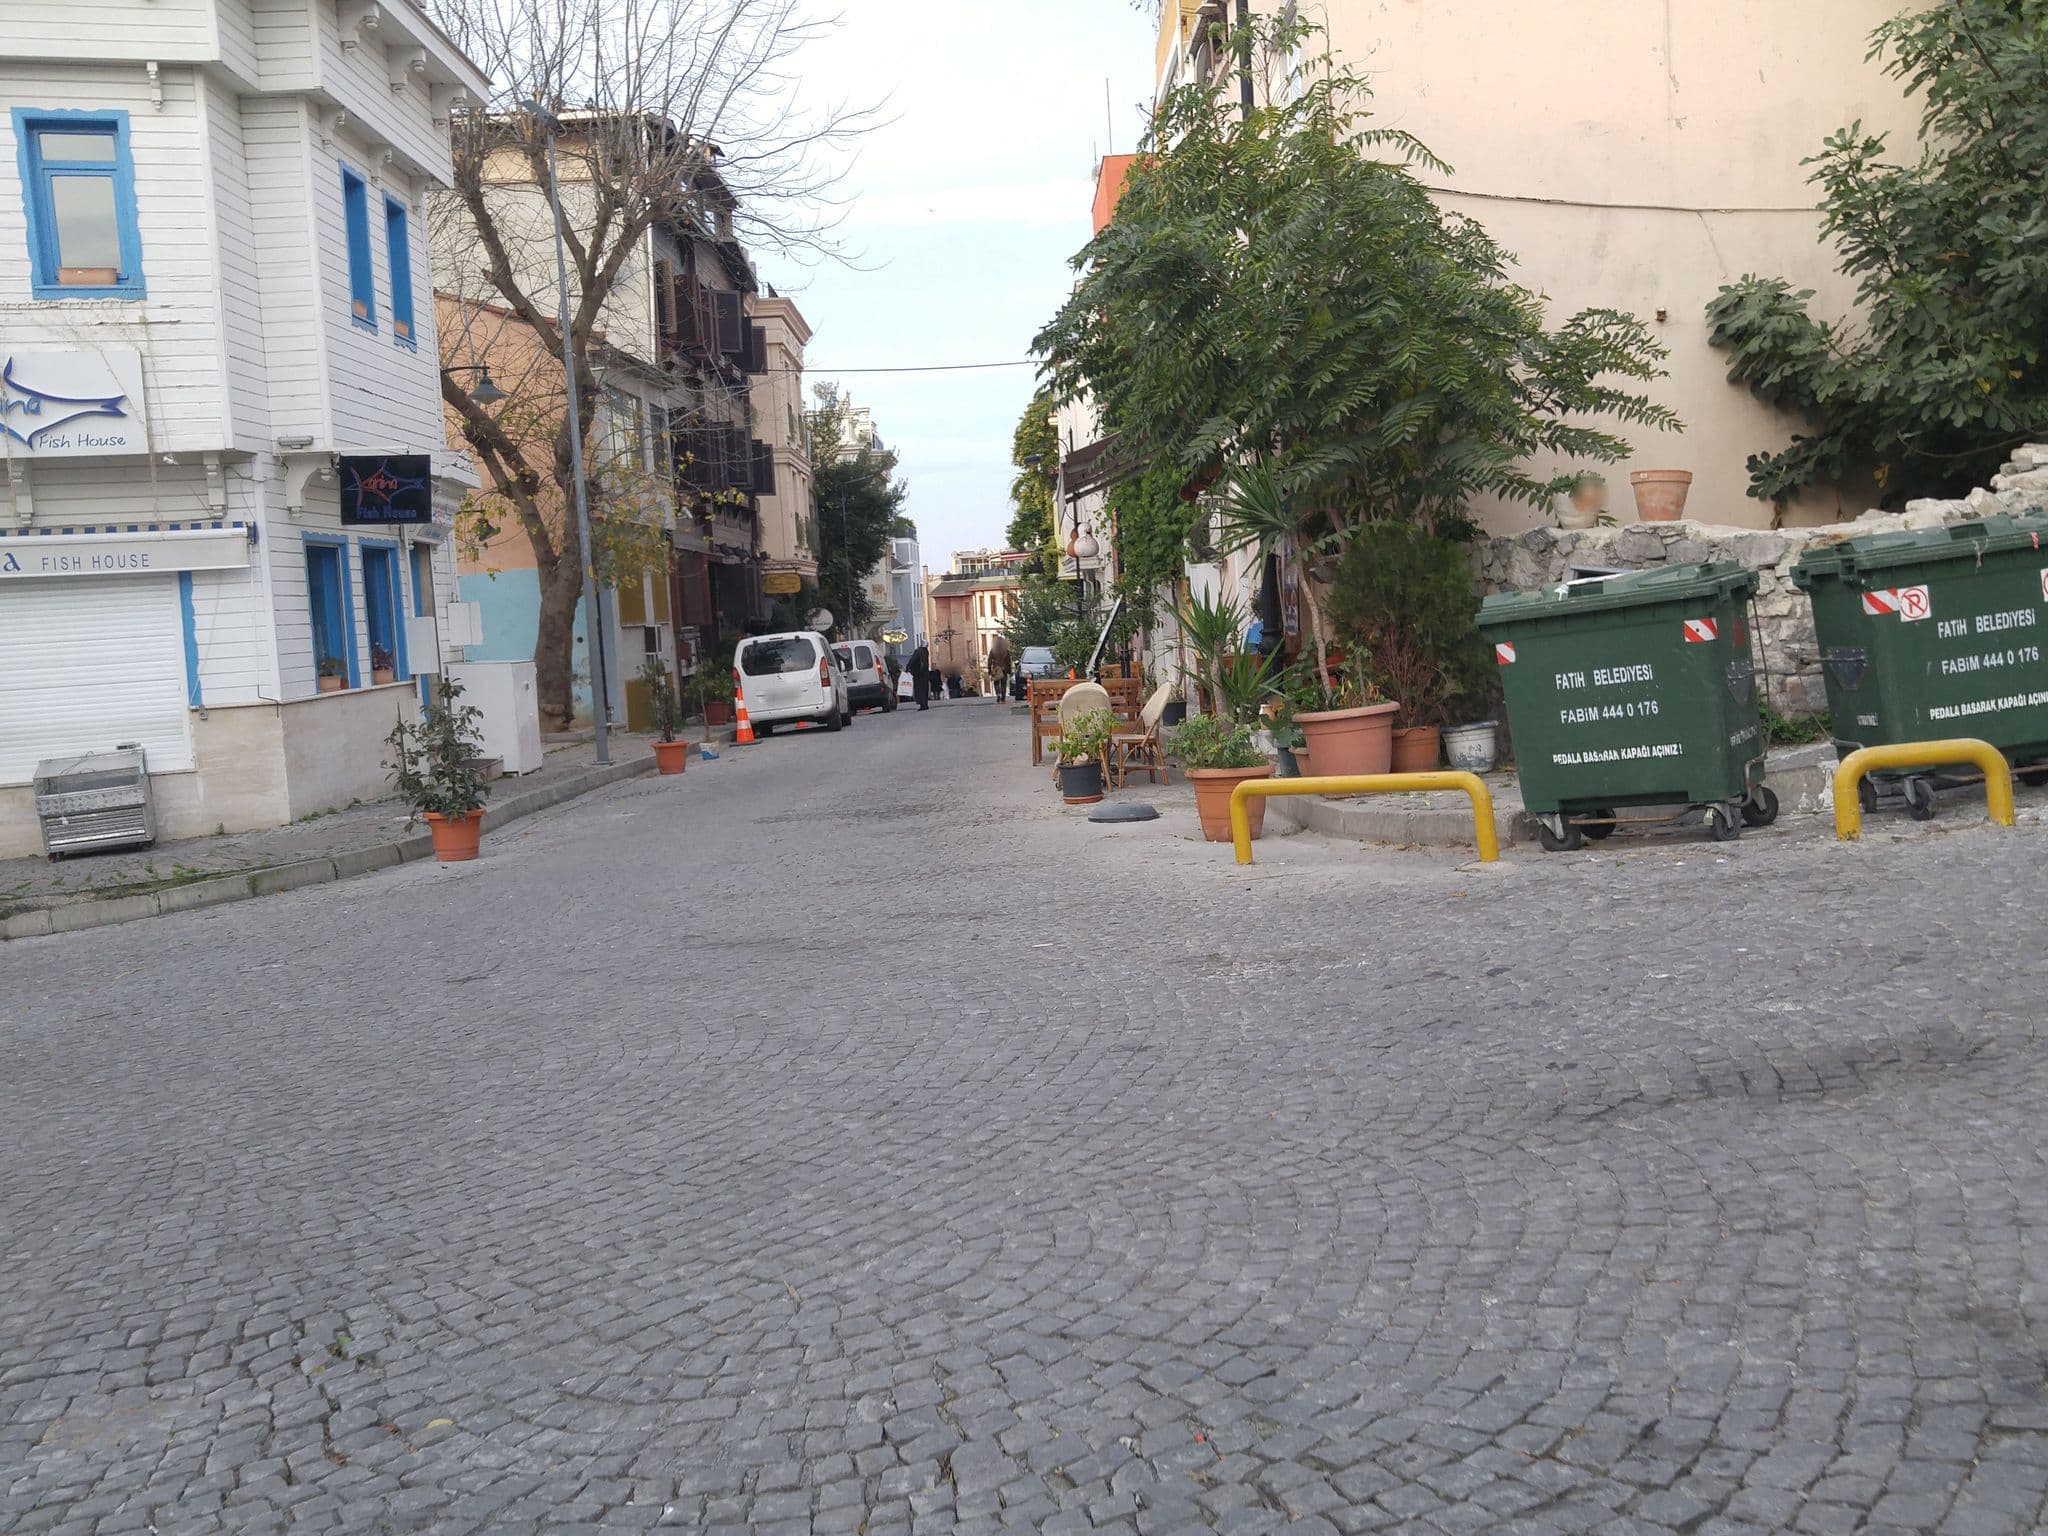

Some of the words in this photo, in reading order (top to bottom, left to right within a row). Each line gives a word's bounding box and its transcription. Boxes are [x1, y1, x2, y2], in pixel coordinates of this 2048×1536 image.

[39, 433, 71, 449] Fish
[78, 432, 126, 448] House
[41, 556, 81, 572] FISH
[92, 553, 150, 569] HOUSE
[1983, 652, 2004, 669] 444
[2007, 650, 2014, 665] 0
[2018, 646, 2039, 663] 176
[1602, 704, 1623, 719] 444
[1626, 703, 1633, 717] 0
[1637, 700, 1659, 716] 176
[1929, 705, 1960, 720] PEDALA
[1961, 699, 1998, 716] BASARAK
[1552, 752, 1582, 765] PEDALA
